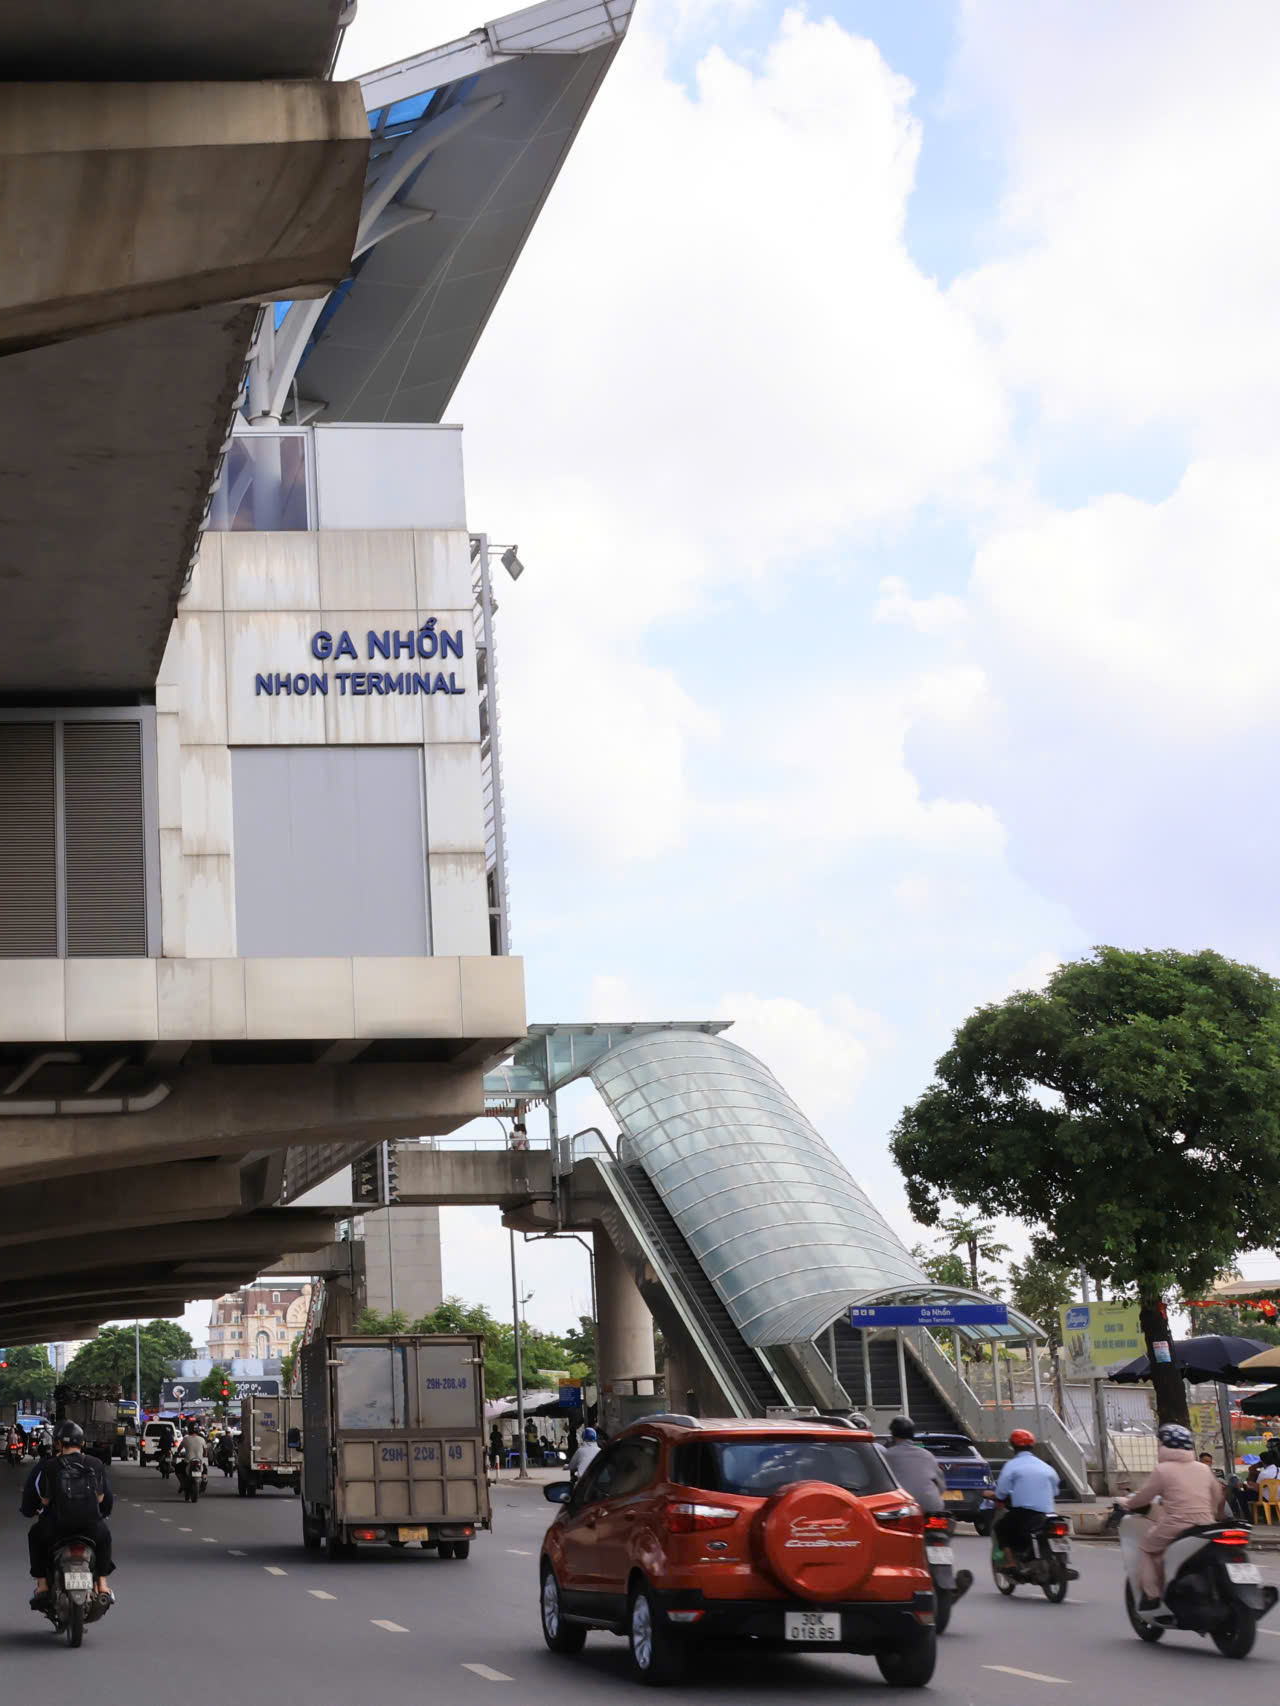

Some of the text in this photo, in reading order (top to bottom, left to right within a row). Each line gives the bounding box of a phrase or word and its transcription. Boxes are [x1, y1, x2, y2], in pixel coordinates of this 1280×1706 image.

[311, 617, 464, 660] GA NHỔN
[255, 672, 466, 696] NHON TERMINAL
[801, 1613, 825, 1626] 30K
